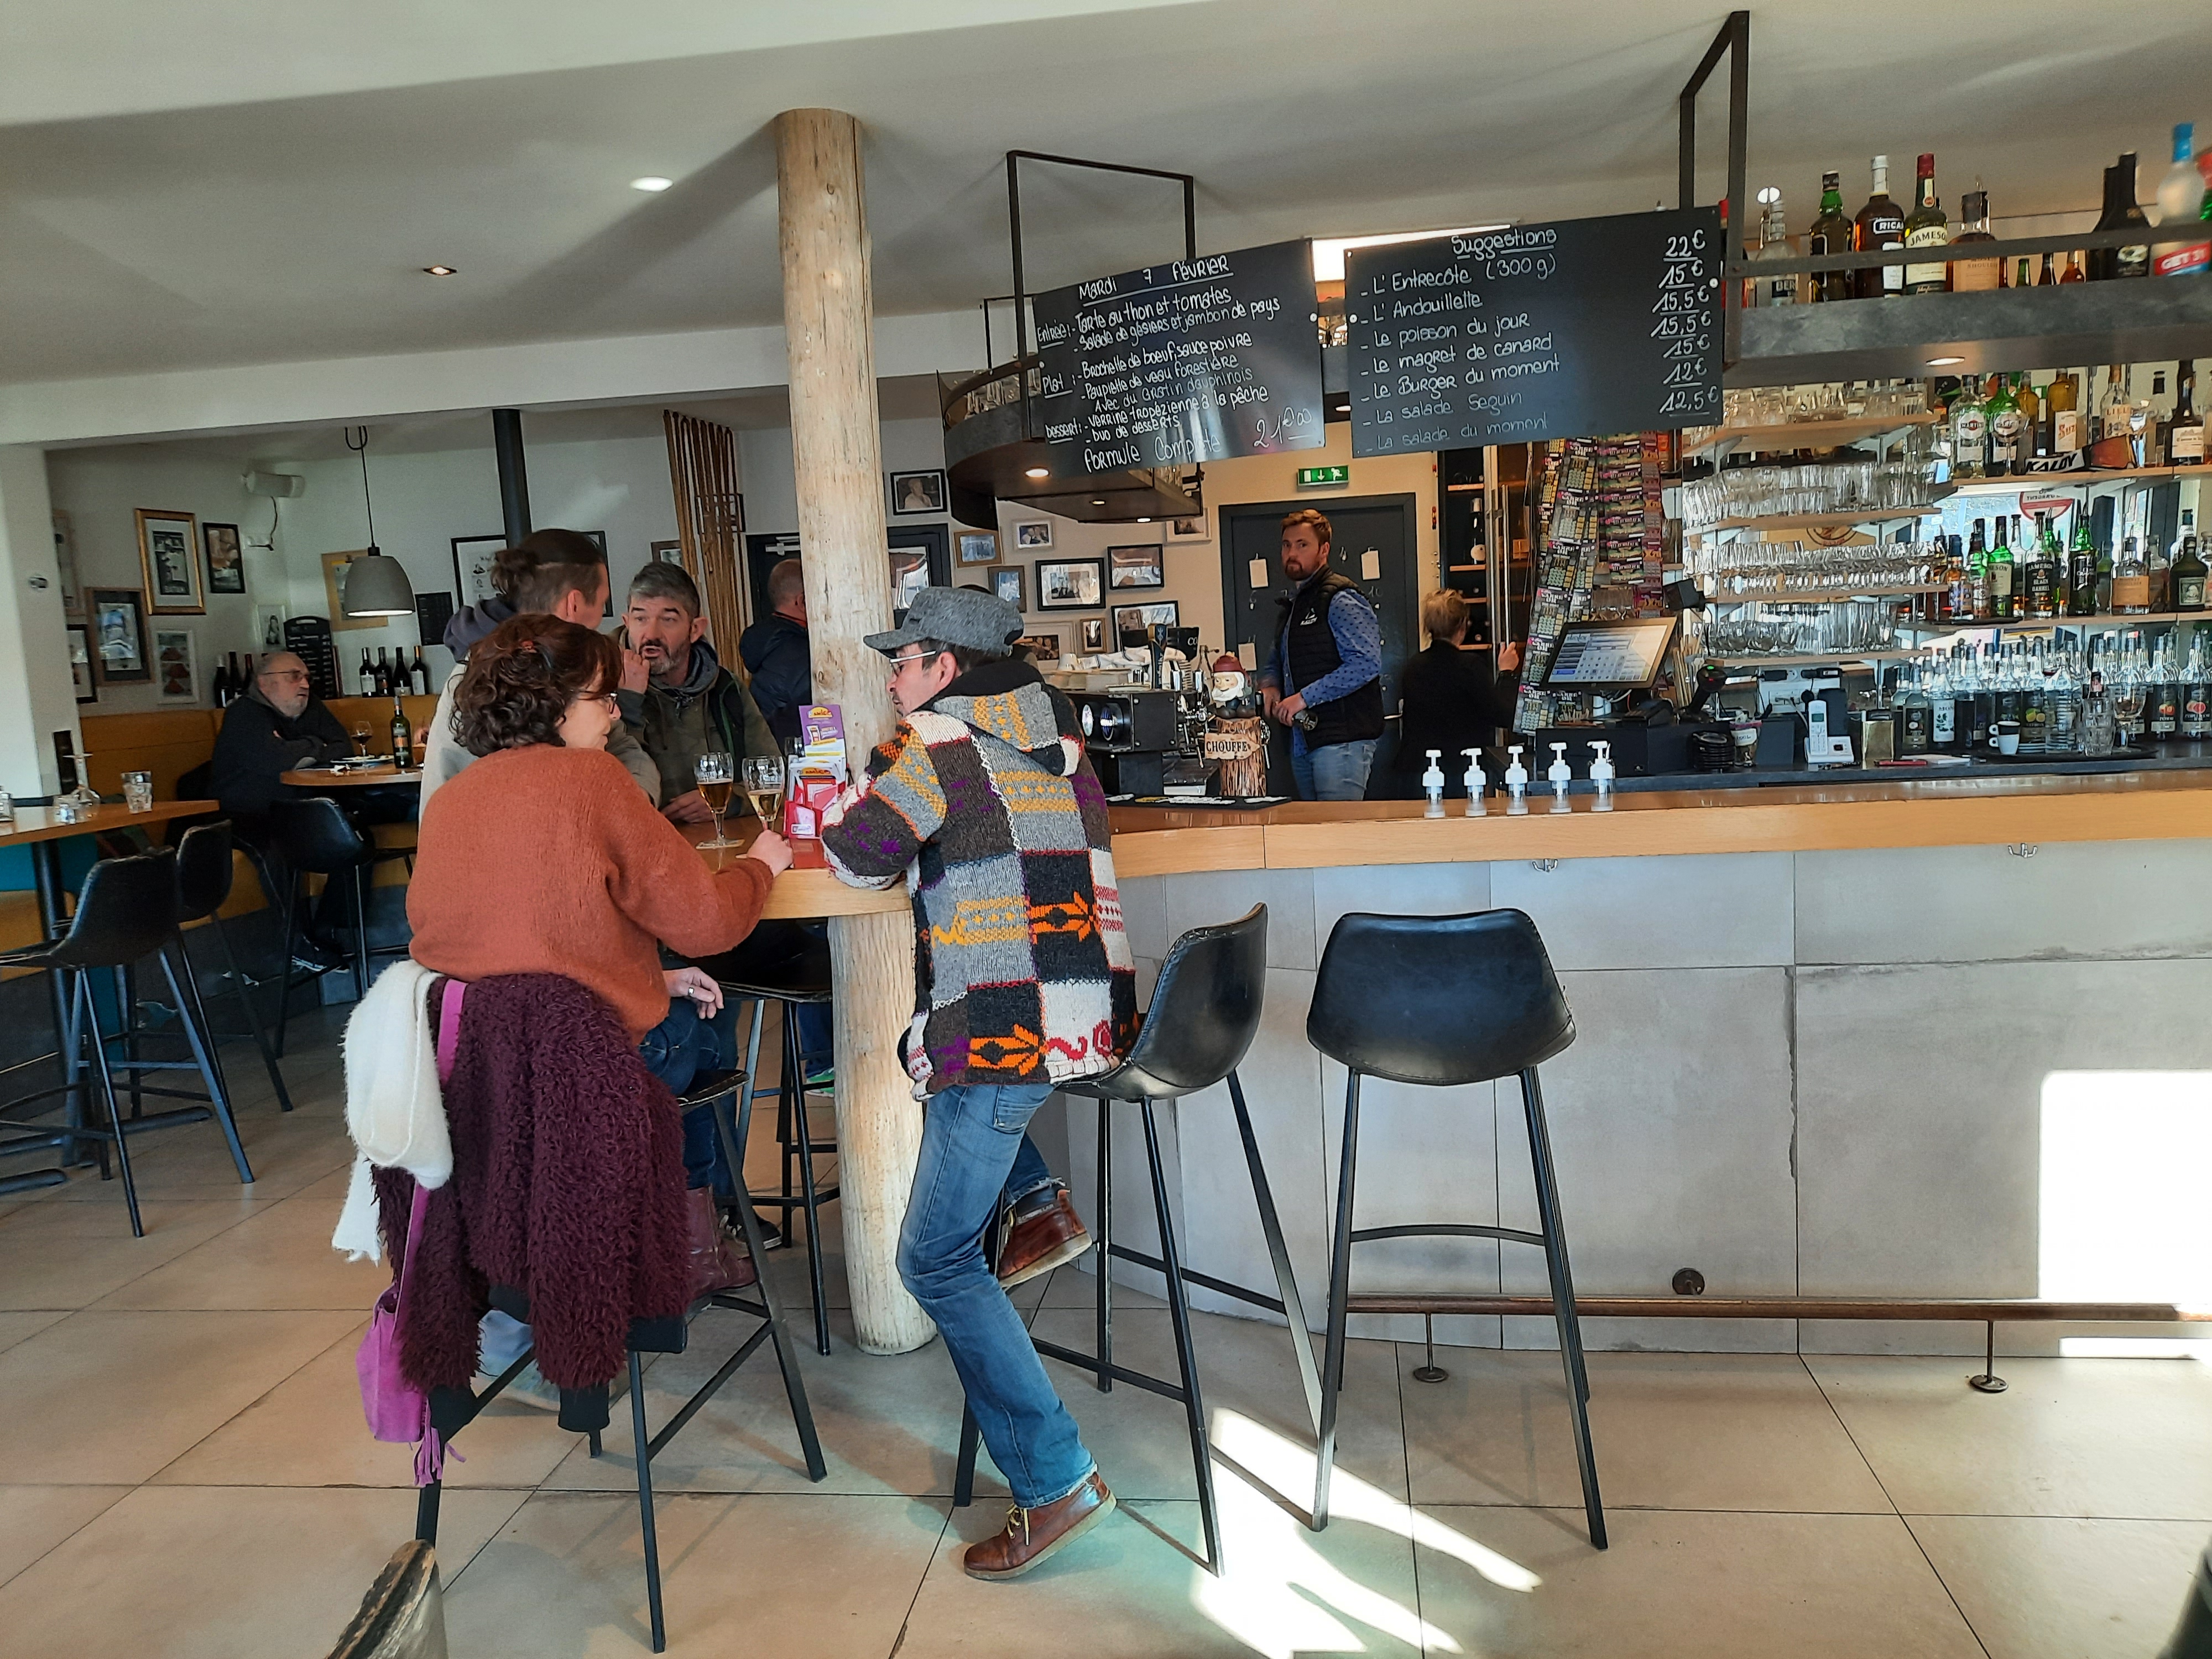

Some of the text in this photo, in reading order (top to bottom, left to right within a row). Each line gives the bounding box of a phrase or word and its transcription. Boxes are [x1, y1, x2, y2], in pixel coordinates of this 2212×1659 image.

[1451, 228, 1557, 262] Suggestions
[1665, 229, 1705, 257] 22€
[1142, 268, 1152, 284] 7
[1391, 264, 1472, 292] Entrecôte
[1658, 259, 1703, 289] 15€
[1108, 310, 1124, 327] au
[1124, 301, 1155, 321] thon
[1156, 295, 1170, 315] et
[1172, 285, 1232, 311] tomates
[1392, 290, 1483, 319] Andouillette
[1116, 326, 1129, 342] de
[1171, 312, 1183, 330] et
[1181, 307, 1230, 333] jambon
[1232, 300, 1247, 320] de
[1250, 298, 1281, 321] pays
[1399, 324, 1457, 349] poisson
[1467, 317, 1488, 335] du
[1494, 312, 1530, 338] jour
[1128, 352, 1141, 369] de
[1177, 341, 1209, 357] sauce
[1210, 331, 1253, 357] poivre
[1399, 345, 1457, 374] magret
[1467, 343, 1488, 361] de
[1494, 332, 1552, 357] canard
[1663, 333, 1710, 358] 15€
[1129, 372, 1142, 389] de
[1145, 367, 1173, 383] veau
[1397, 375, 1458, 400] Burger
[1465, 367, 1484, 384] du
[1491, 353, 1560, 381] moment
[1663, 357, 1707, 385] 12€
[1123, 393, 1138, 408] du
[1187, 367, 1253, 392] dauphinois
[1660, 385, 1719, 413] 12,5€
[1129, 396, 1200, 421] tropézienne
[1201, 393, 1210, 409] à
[1213, 390, 1227, 406] la
[1230, 385, 1269, 410] pêche
[1376, 392, 1522, 424] La salade Seguin
[1115, 425, 1129, 439] de
[1131, 415, 1180, 435] desserts
[1377, 435, 1393, 450] La
[1402, 426, 1450, 446] salade
[1460, 424, 1478, 437] du
[1155, 428, 1222, 463] Complte
[1206, 741, 1247, 752] CHOUFFE
